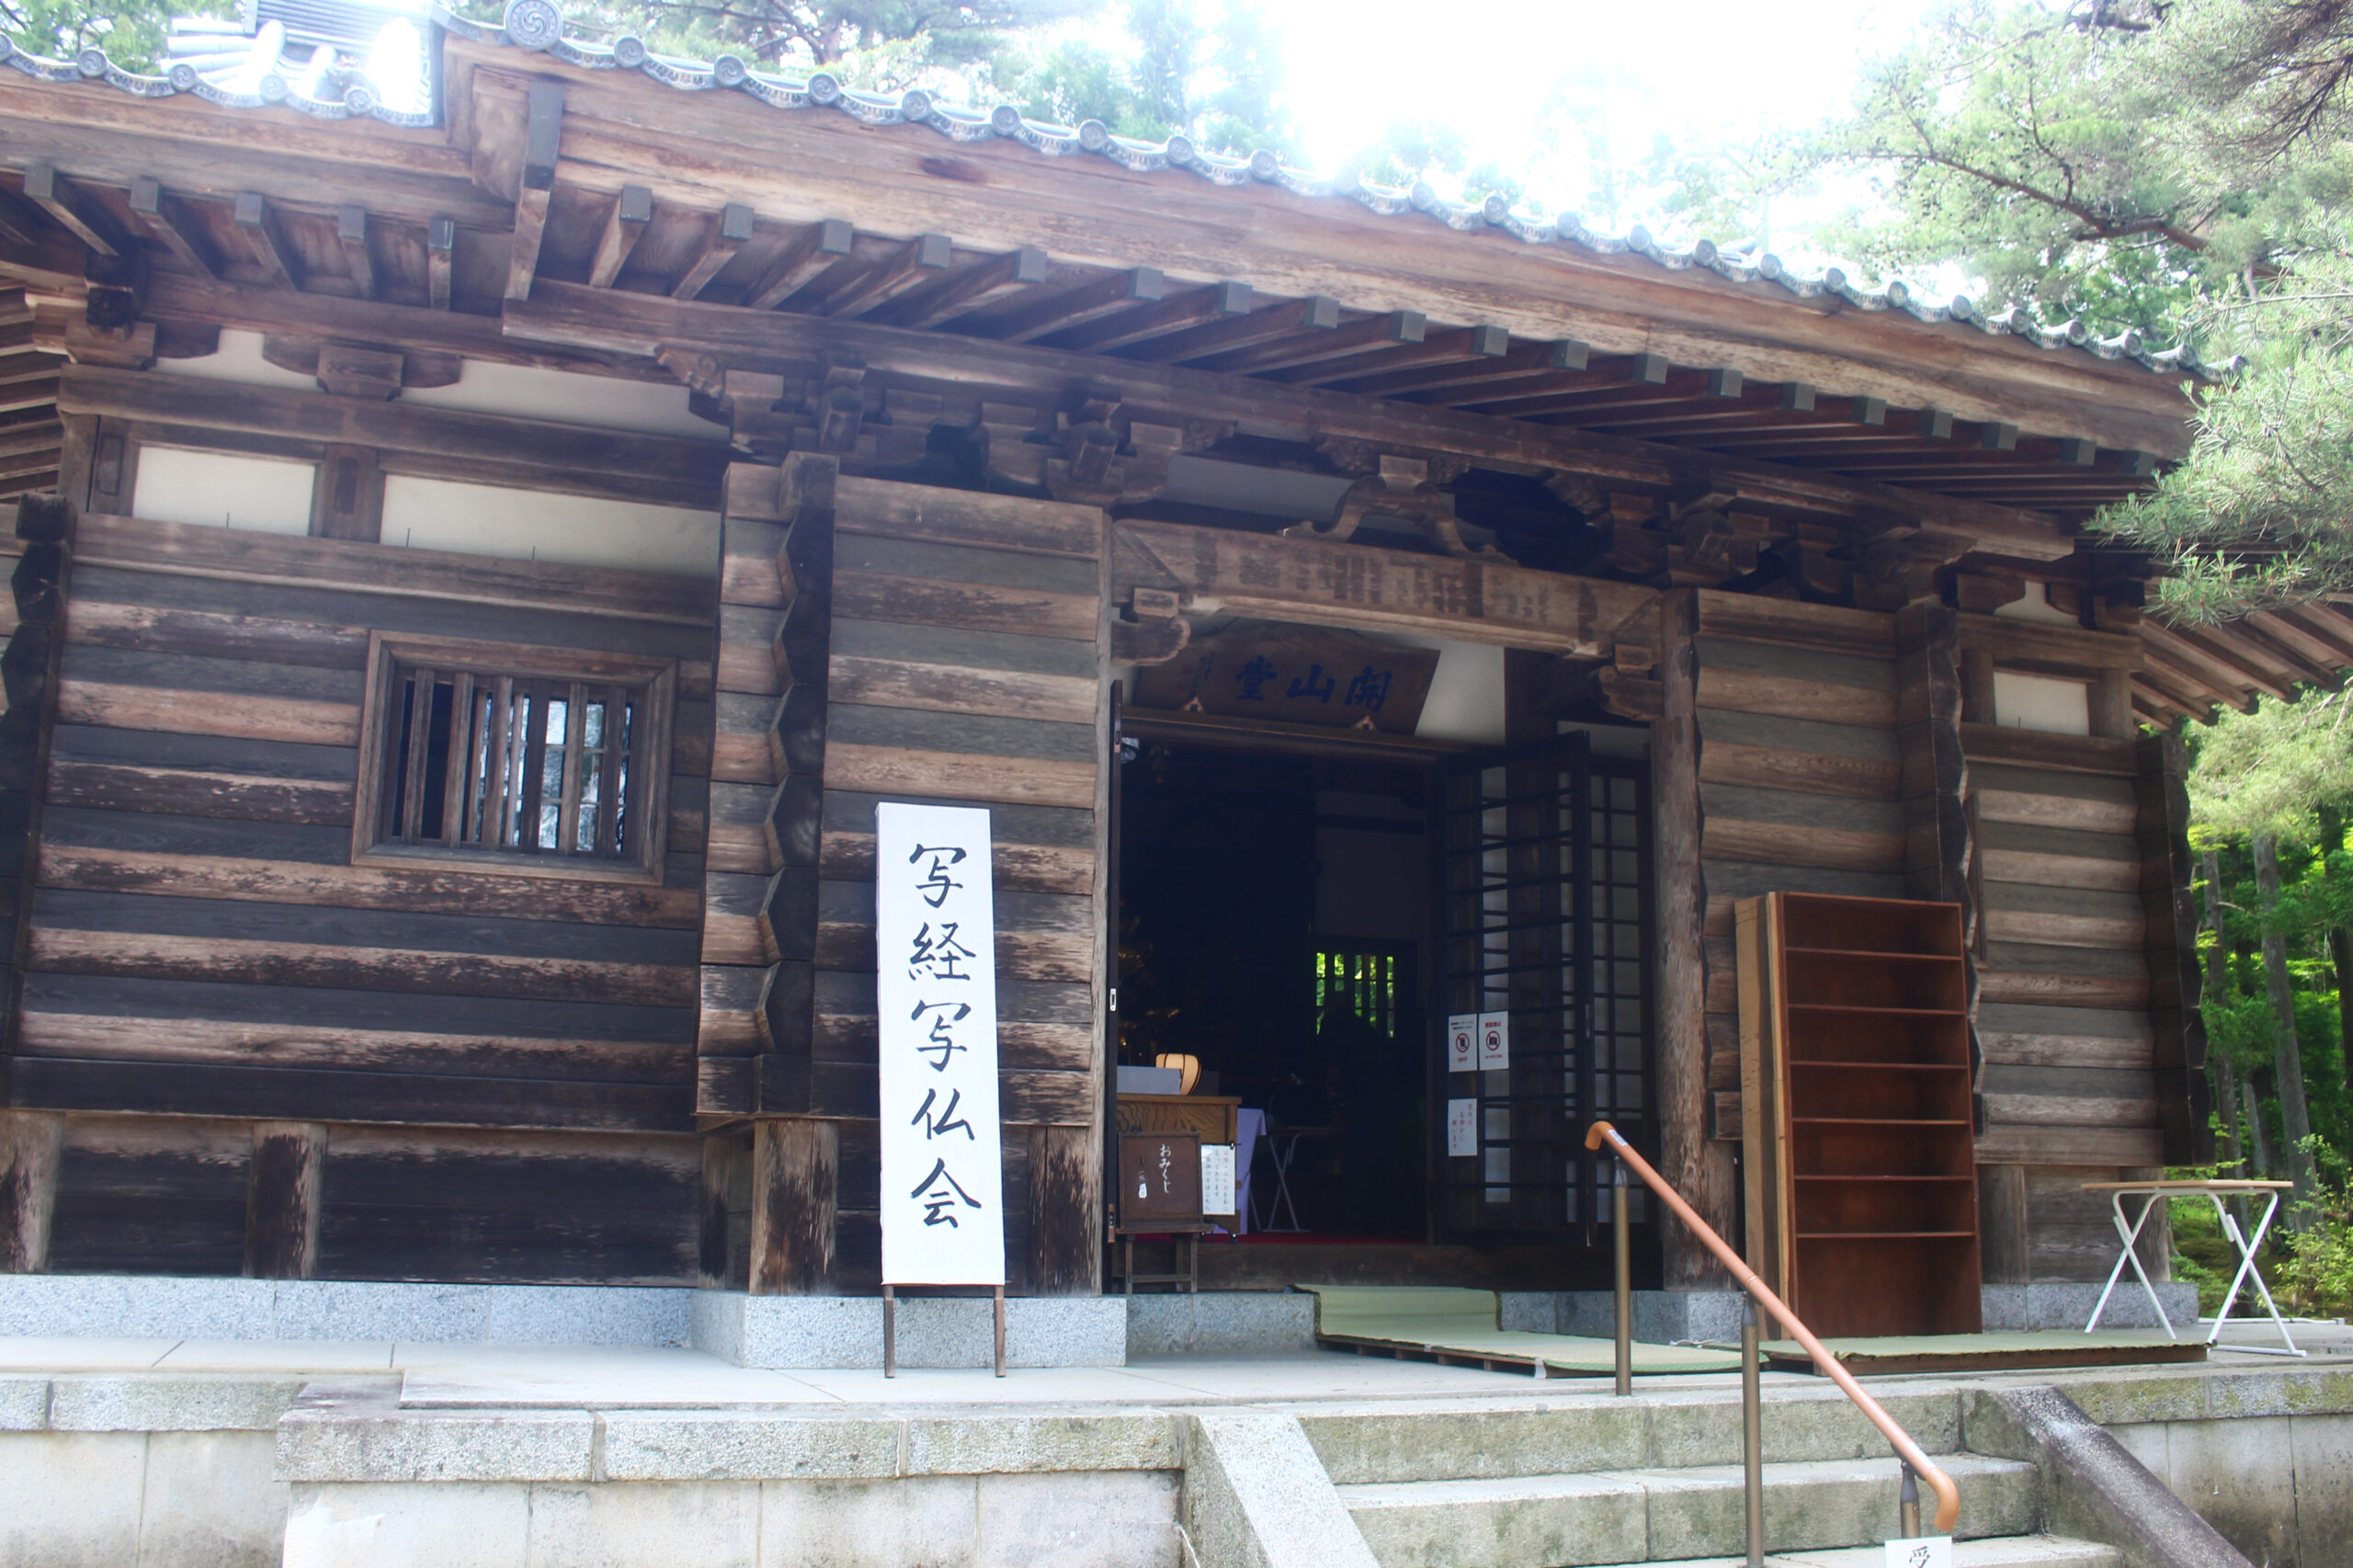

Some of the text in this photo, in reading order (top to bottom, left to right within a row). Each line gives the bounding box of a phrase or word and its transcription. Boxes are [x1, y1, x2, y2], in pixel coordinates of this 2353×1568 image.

[1234, 653, 1392, 712] 開山堂
[909, 843, 982, 1229] 写経写仏会
[1158, 1143, 1172, 1194] おみくじ
